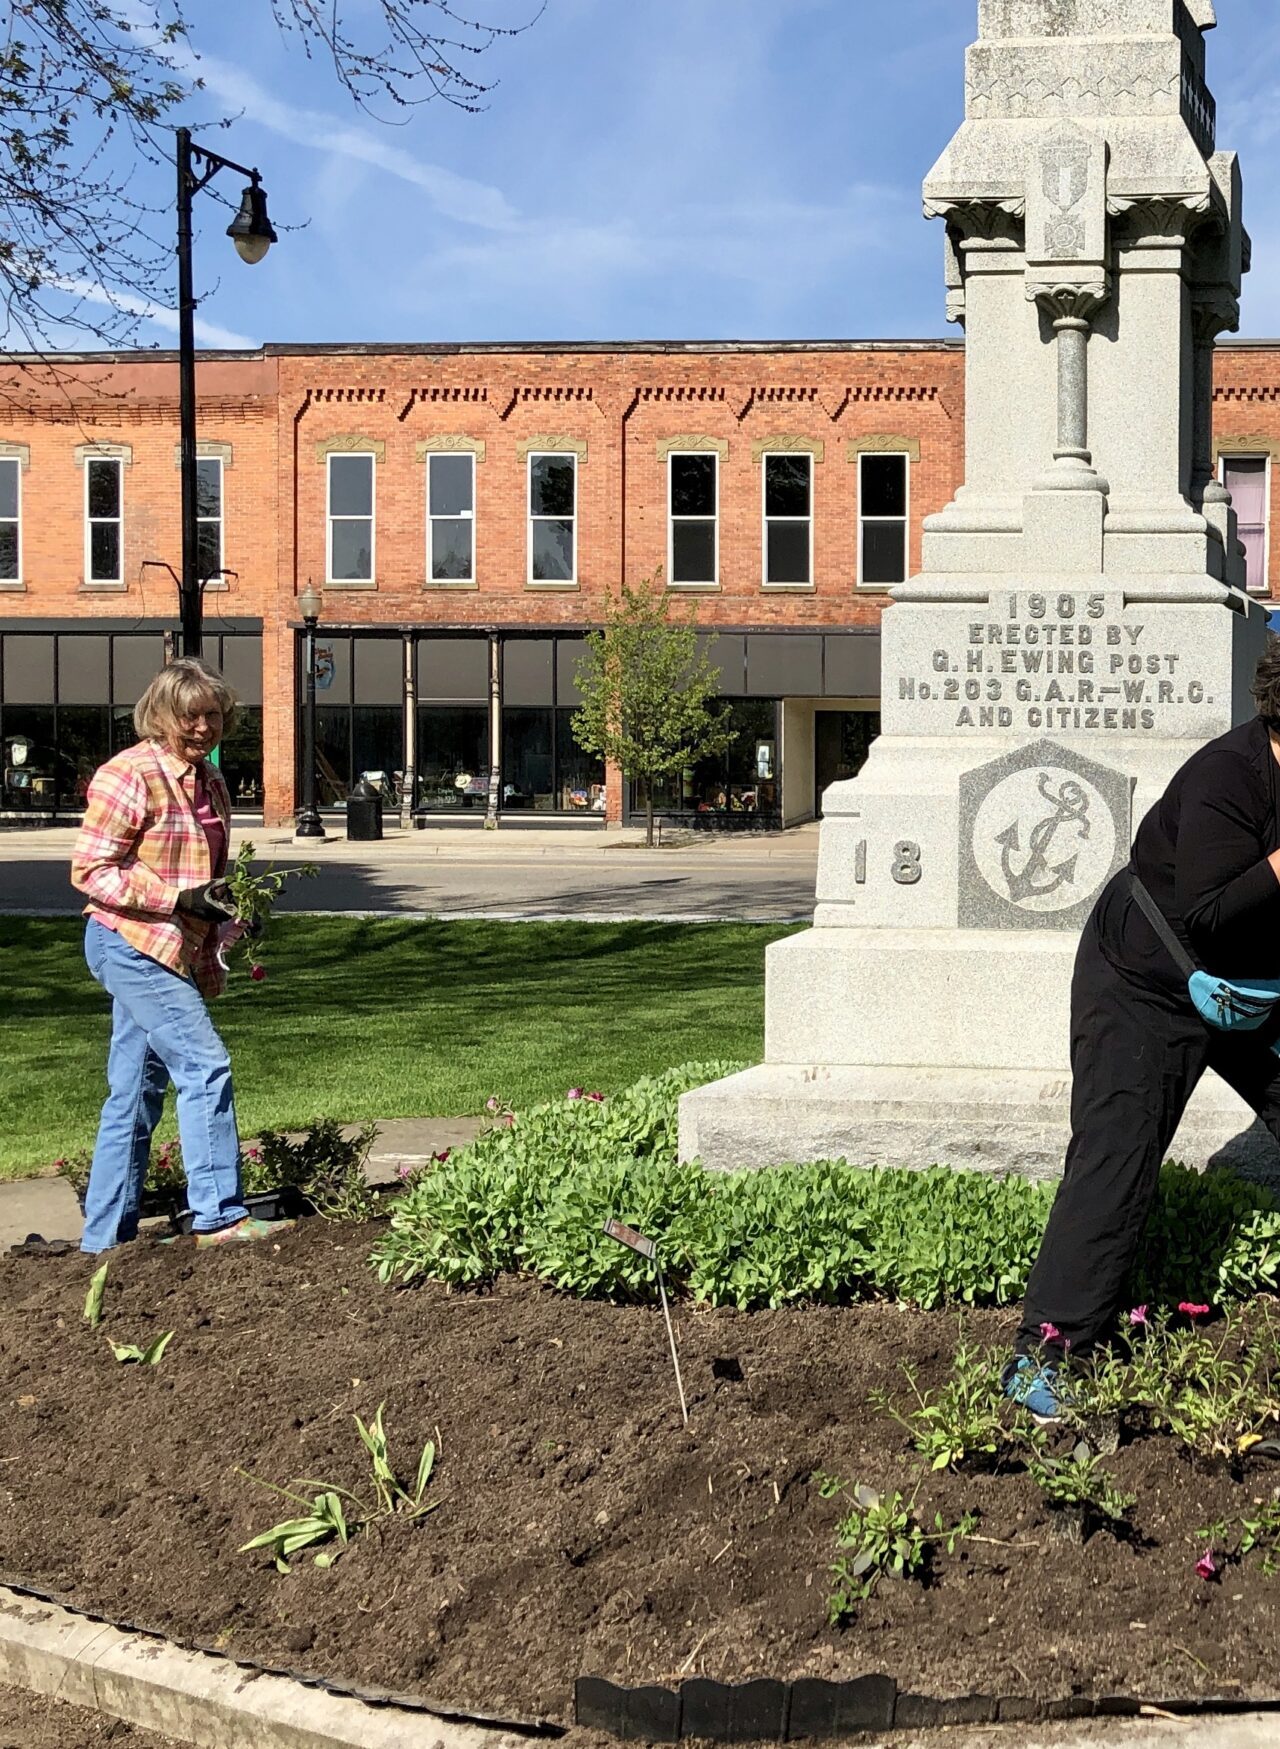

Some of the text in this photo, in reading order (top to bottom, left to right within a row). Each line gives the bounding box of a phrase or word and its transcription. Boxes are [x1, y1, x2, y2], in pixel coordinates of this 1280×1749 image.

[1008, 592, 1105, 619] 1905
[968, 622, 1145, 645] ERECTED BY
[1109, 653, 1180, 674] POST
[955, 705, 1155, 729] AND CITIZENS
[854, 839, 922, 885] 18
